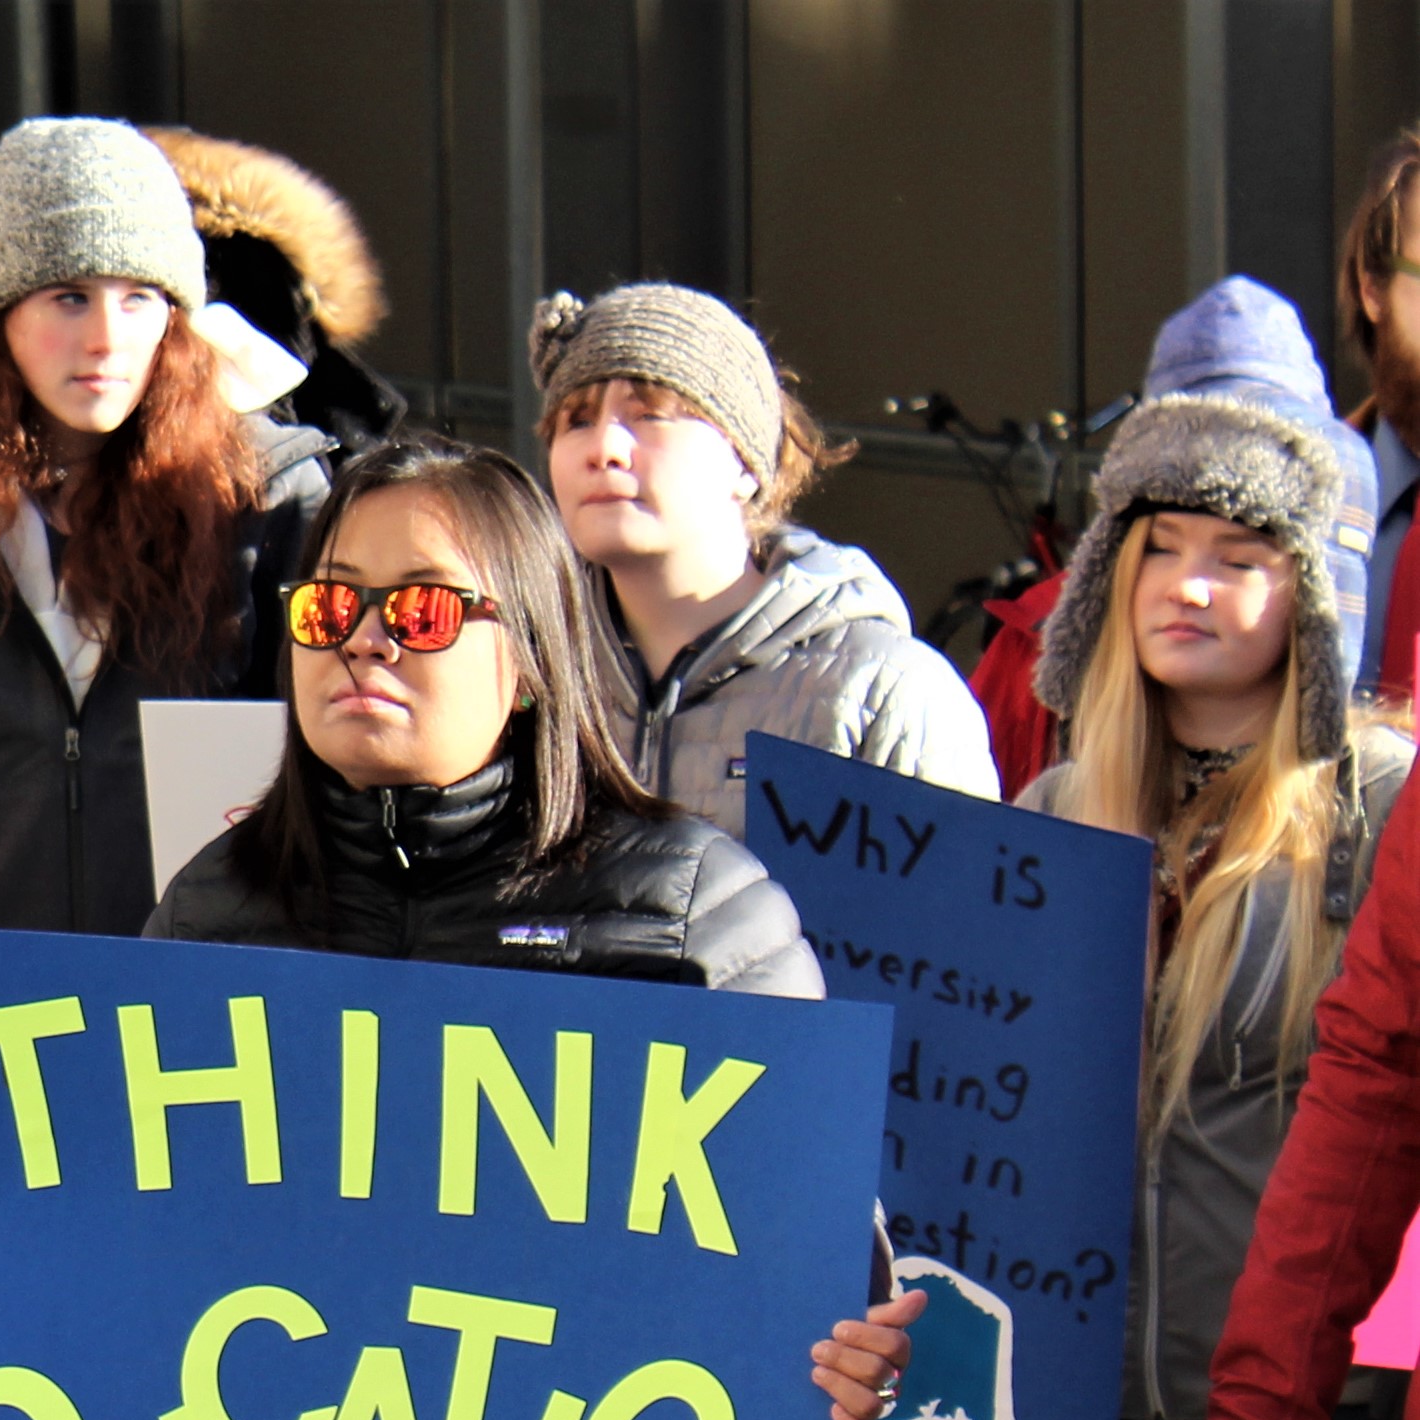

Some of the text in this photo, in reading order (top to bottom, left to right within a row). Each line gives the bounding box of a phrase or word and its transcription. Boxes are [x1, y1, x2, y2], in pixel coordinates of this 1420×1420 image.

[890, 1039, 1029, 1122] ding
[963, 1141, 1023, 1197] in
[890, 1210, 1116, 1324] estion?
